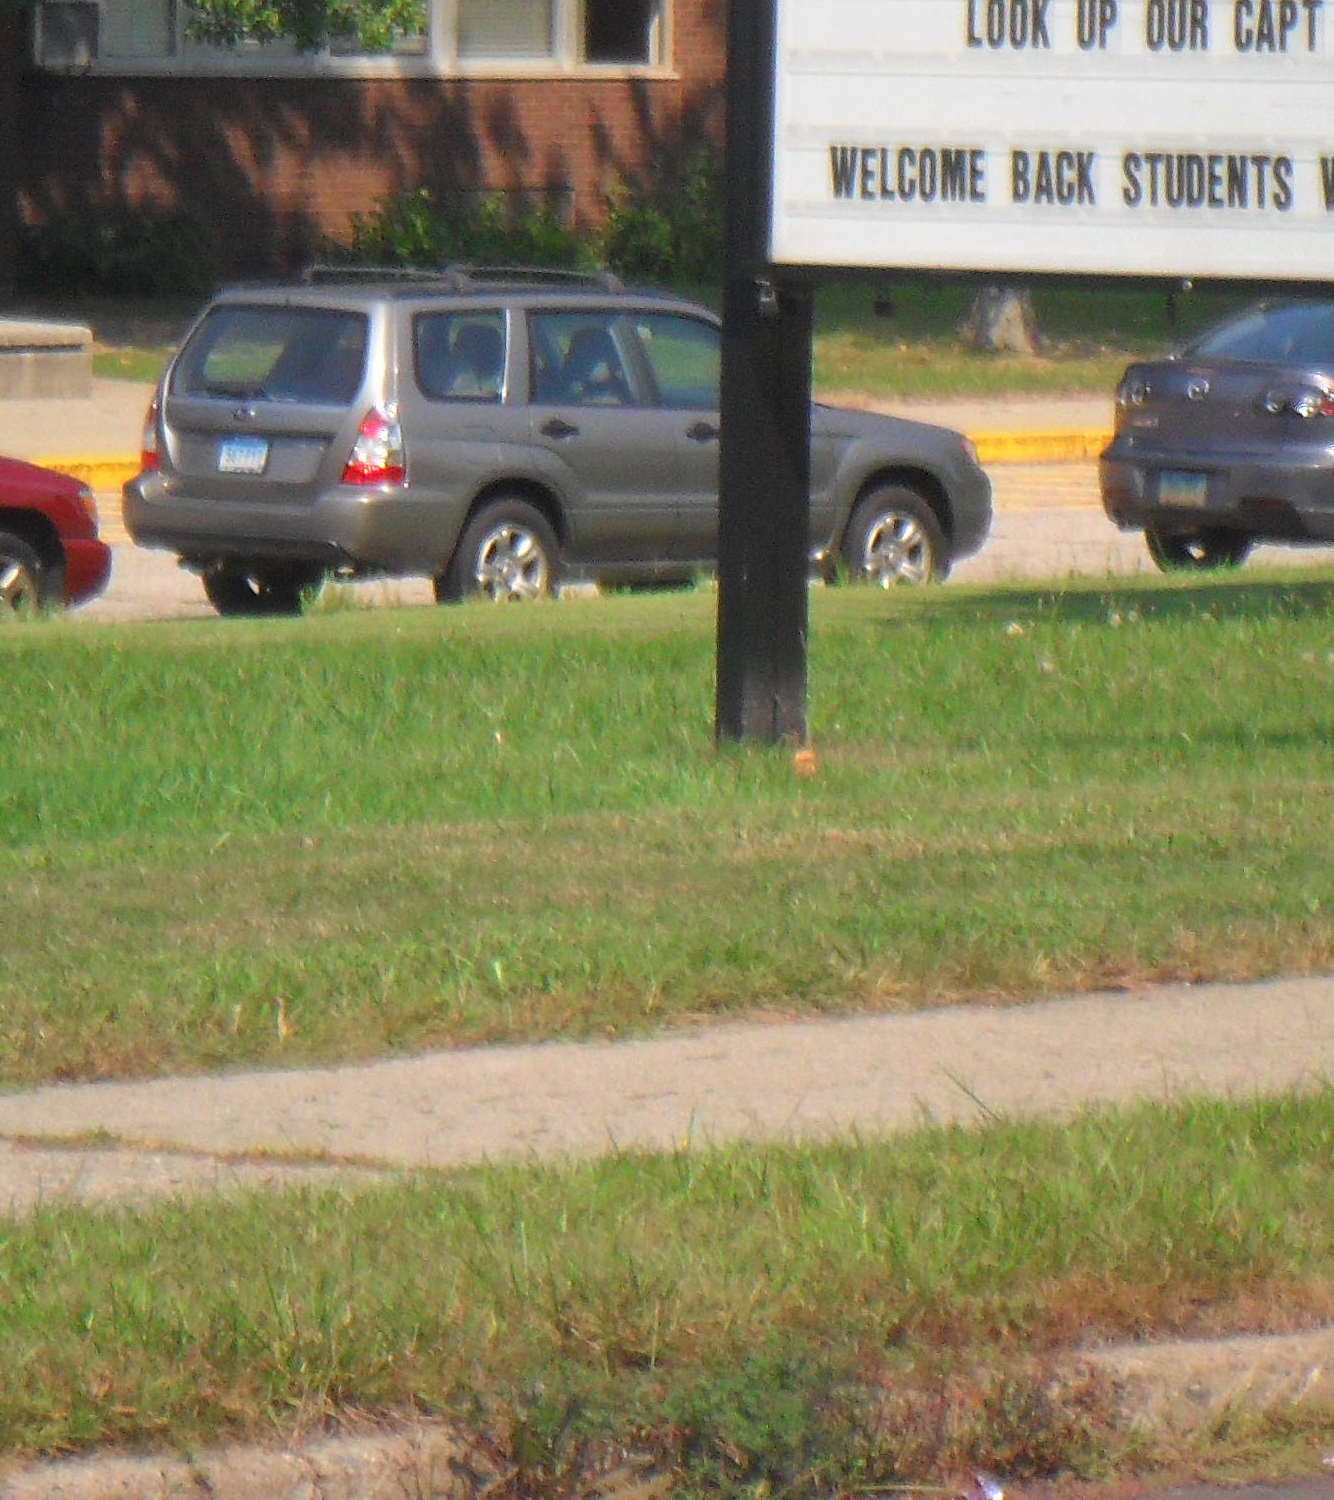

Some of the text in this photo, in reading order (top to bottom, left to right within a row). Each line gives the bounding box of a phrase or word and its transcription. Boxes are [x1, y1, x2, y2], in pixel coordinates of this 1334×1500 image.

[829, 145, 984, 200] WELCOME
[1011, 149, 1095, 204] BACK
[1122, 151, 1292, 211] STUDENTS
